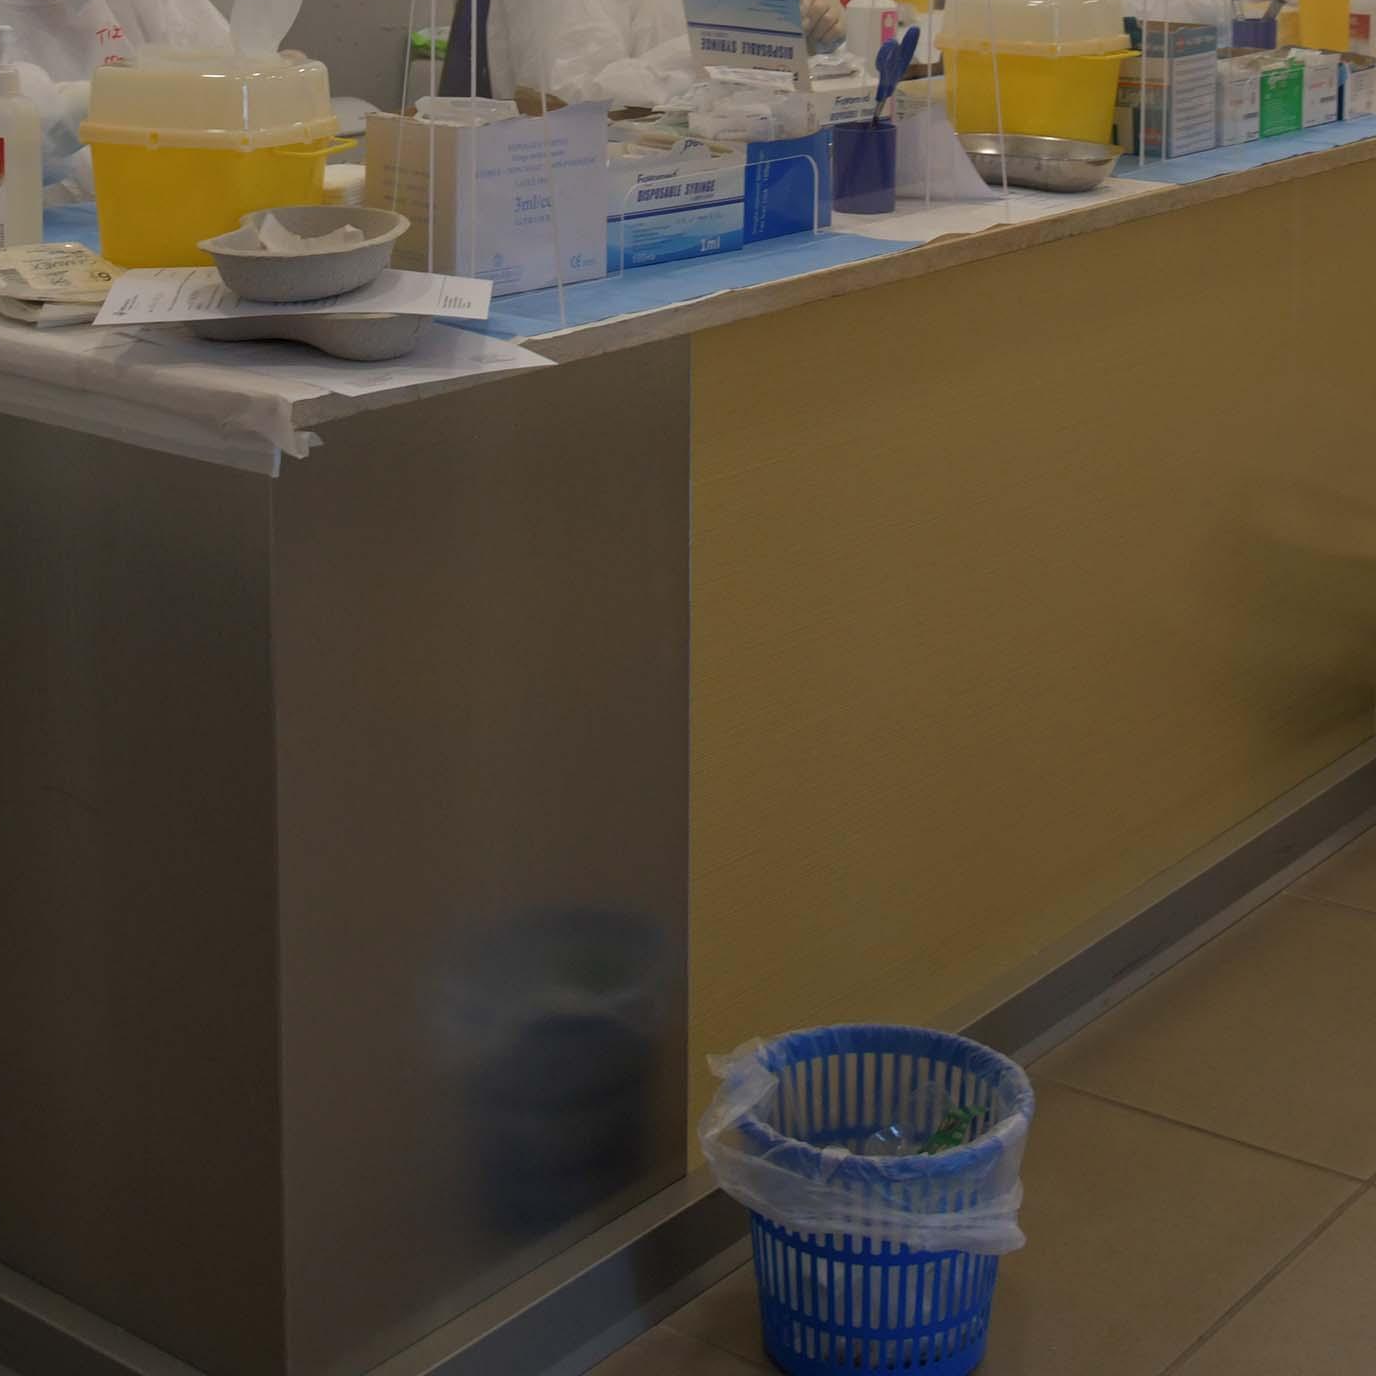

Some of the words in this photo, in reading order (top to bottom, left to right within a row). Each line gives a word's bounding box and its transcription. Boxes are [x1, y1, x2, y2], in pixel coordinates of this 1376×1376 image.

[701, 37, 737, 53] SYRINGE
[742, 42, 793, 59] DISPOSABLE
[637, 183, 681, 202] DISPOSABLE
[684, 179, 716, 196] SYRINGE
[700, 236, 721, 252] 1ml
